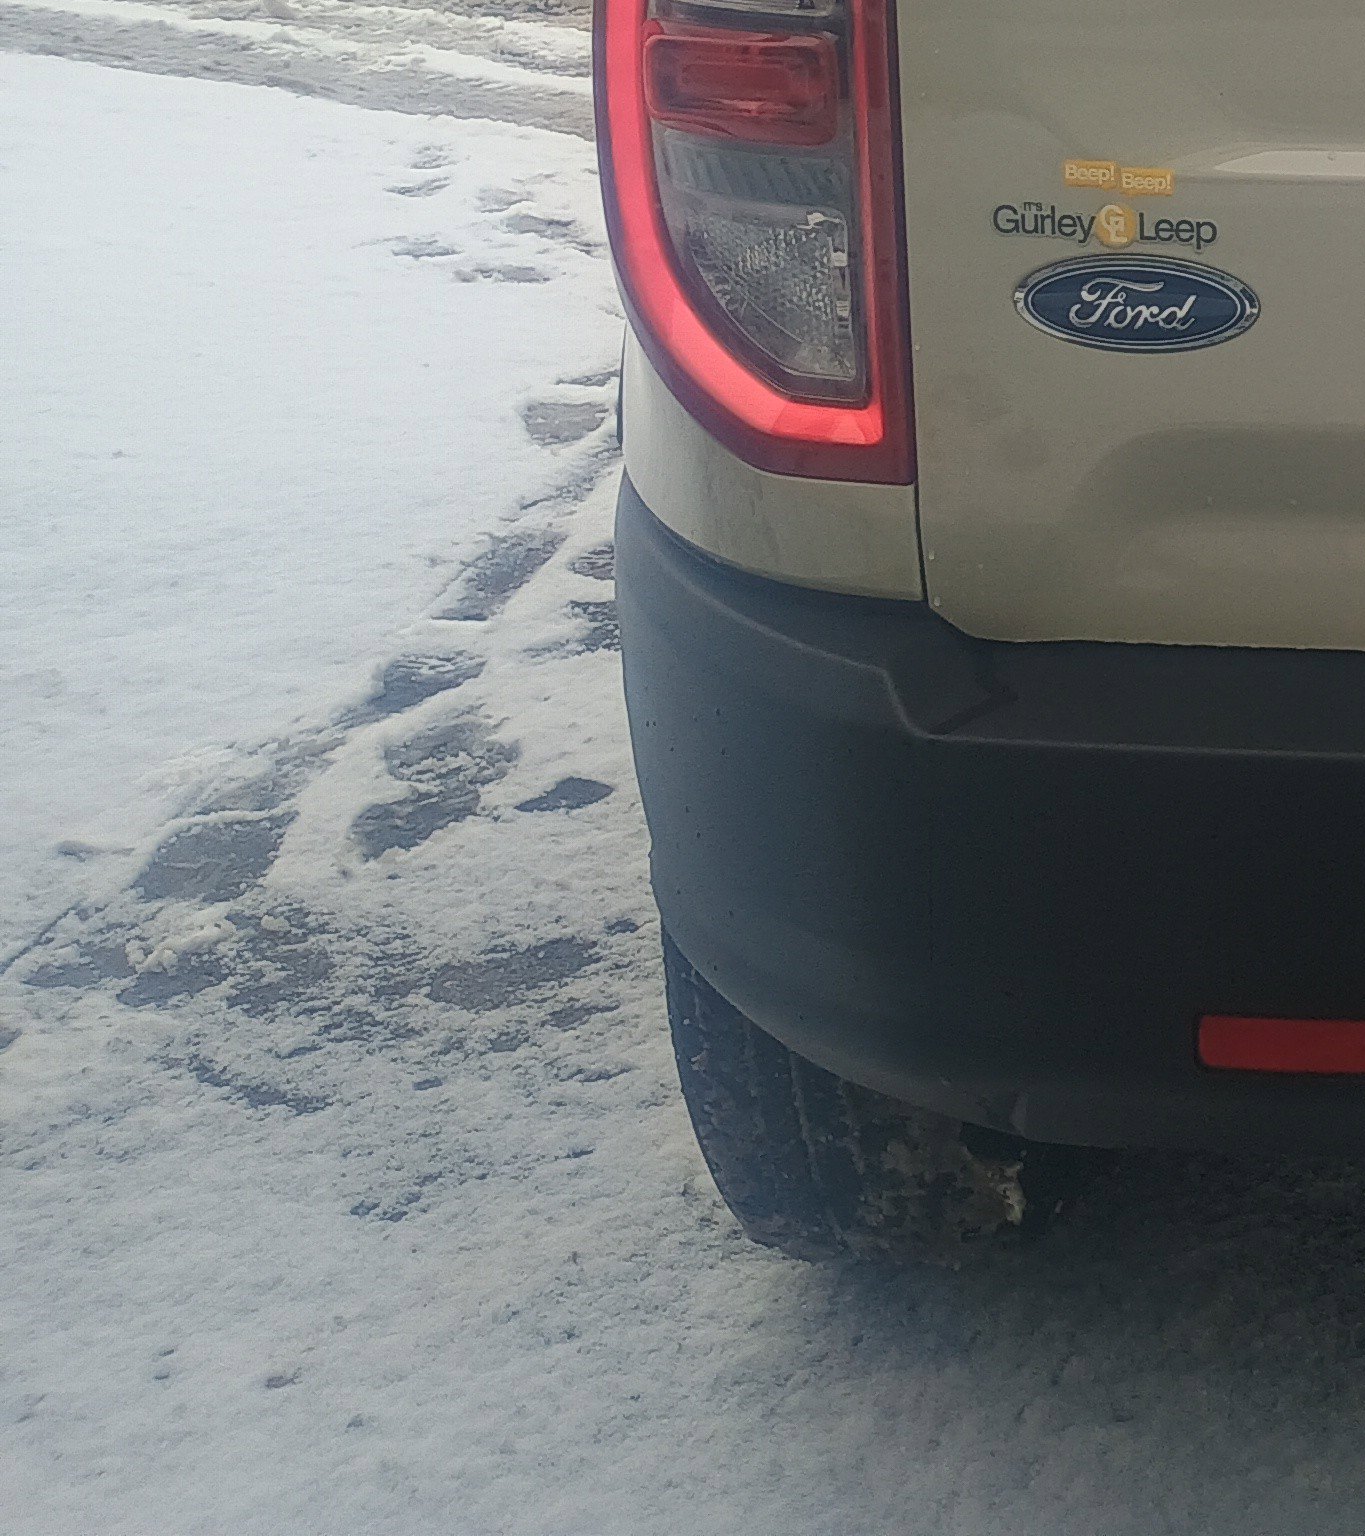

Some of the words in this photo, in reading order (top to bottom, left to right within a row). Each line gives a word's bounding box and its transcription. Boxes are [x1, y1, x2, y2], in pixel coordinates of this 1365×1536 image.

[1064, 164, 1115, 184] Beep!
[1121, 173, 1172, 192] Beep!
[993, 204, 1097, 244] Gurley
[1138, 212, 1218, 250] Leep
[1069, 277, 1198, 330] Ford
